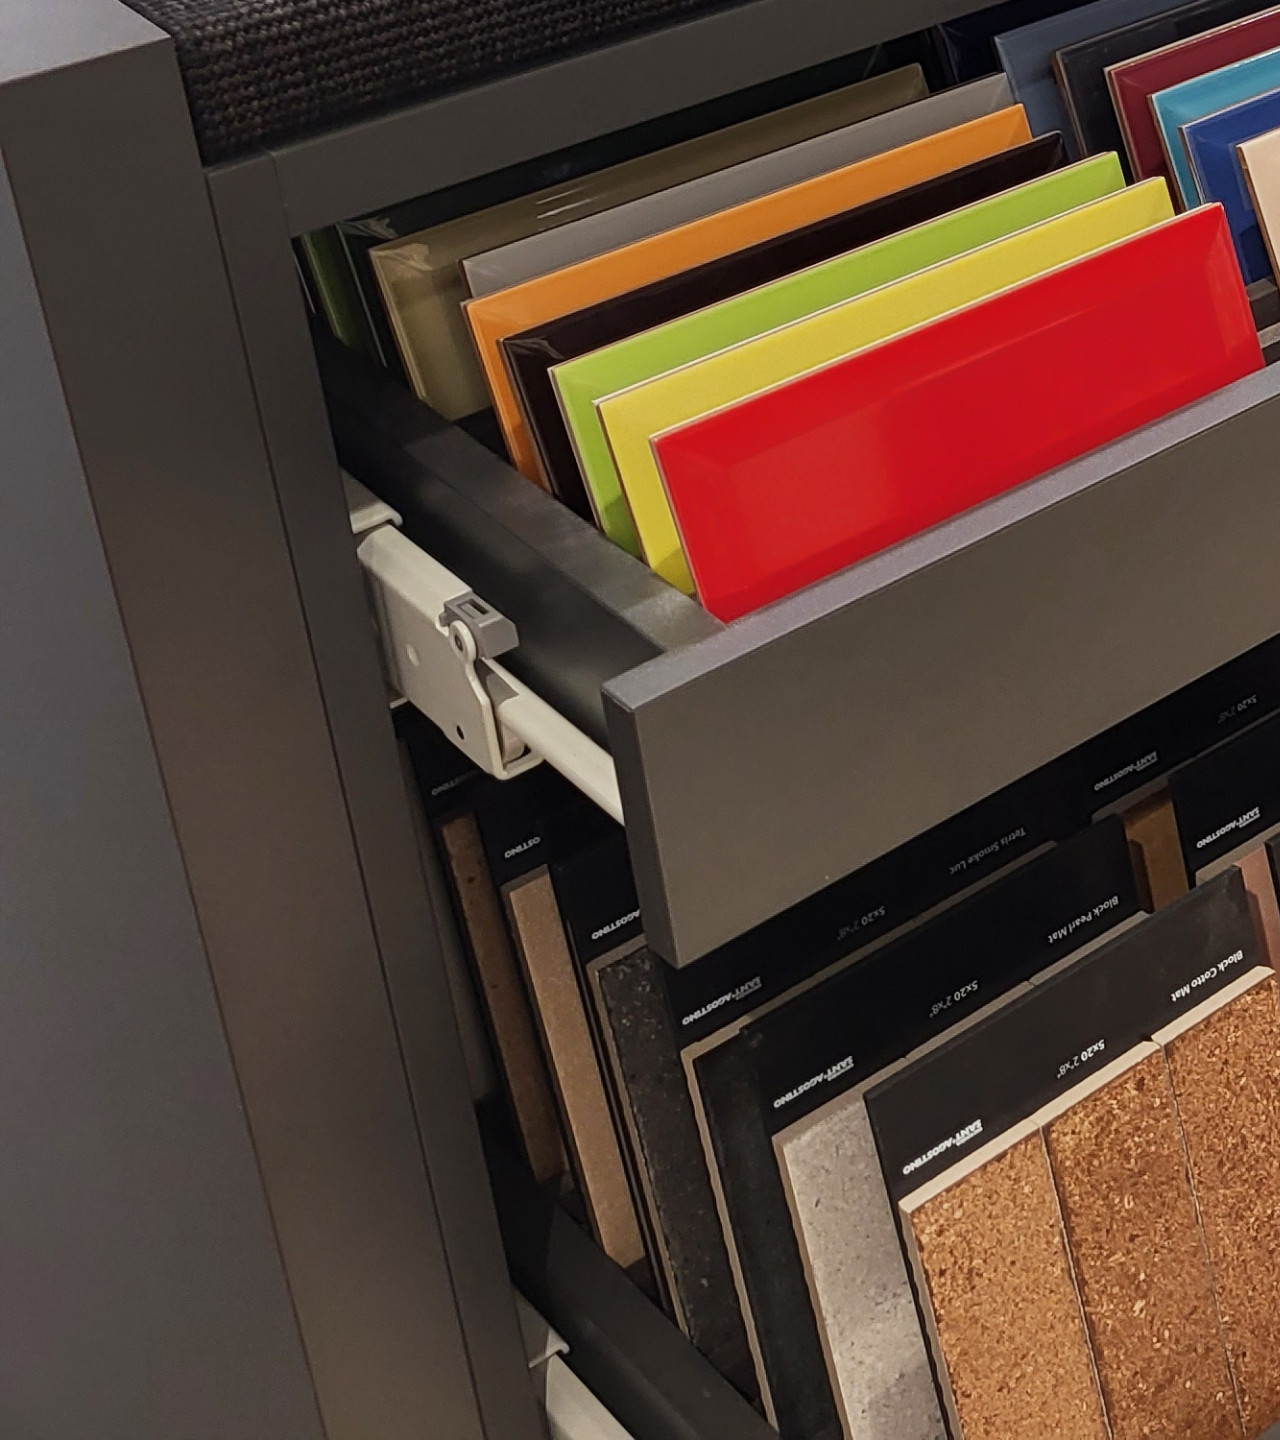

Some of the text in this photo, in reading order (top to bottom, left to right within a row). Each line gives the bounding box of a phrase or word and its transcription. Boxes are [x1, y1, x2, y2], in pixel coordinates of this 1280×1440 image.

[949, 826, 1026, 875] Tetris Smoke Luc
[1047, 895, 1119, 944] Block Pearl Mat
[953, 979, 979, 1001] 5x20
[1170, 950, 1244, 1002] Block Cotto Mat
[1080, 1039, 1106, 1061] 5x20
